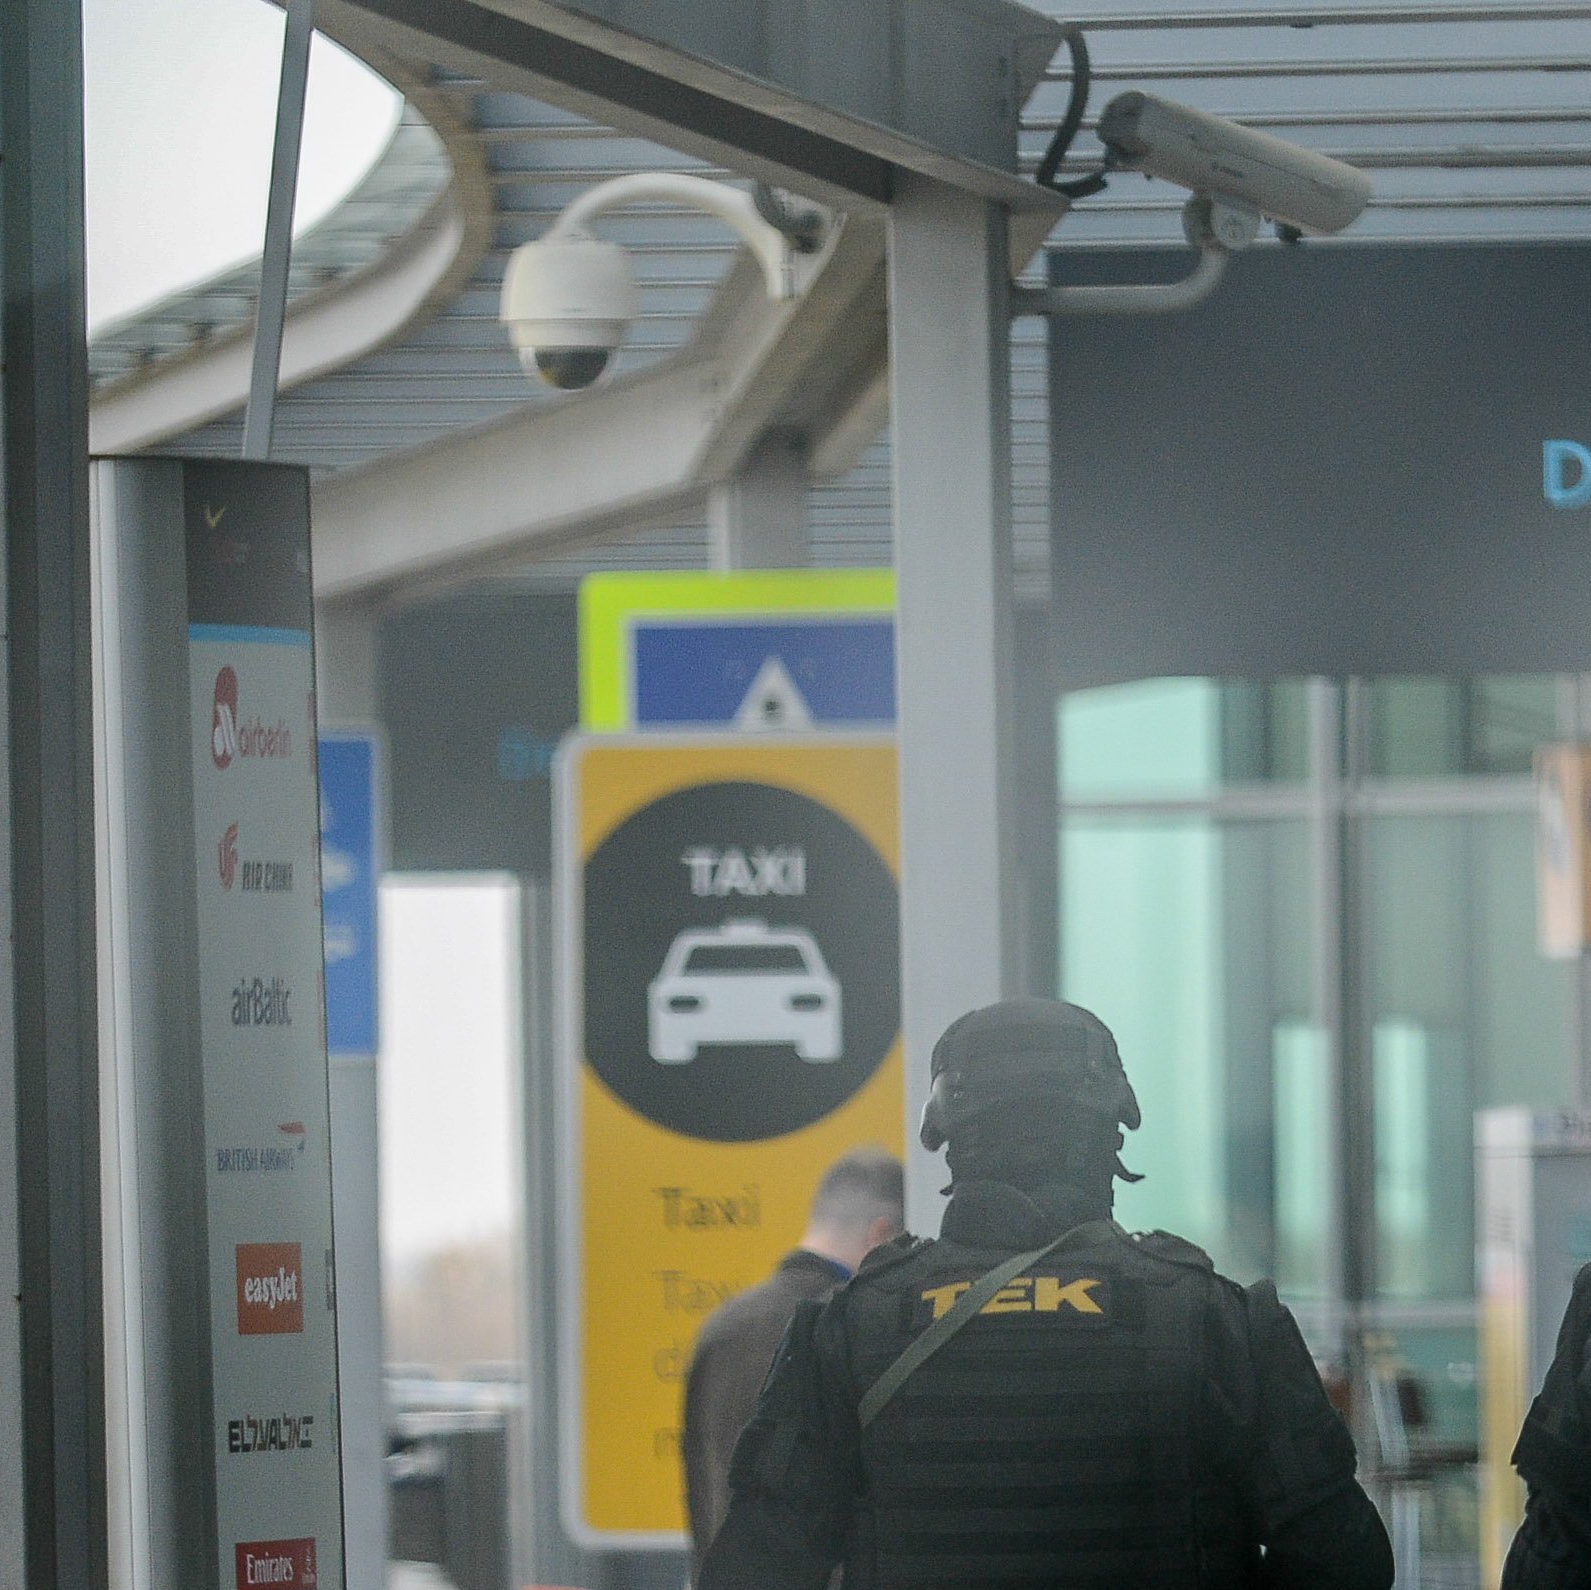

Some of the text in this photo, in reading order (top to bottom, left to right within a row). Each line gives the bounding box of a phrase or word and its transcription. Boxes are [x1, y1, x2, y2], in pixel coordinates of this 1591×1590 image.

[681, 845, 807, 897] TAXI
[654, 1183, 761, 1230] Taxi
[244, 1267, 298, 1310] easyJet
[921, 1276, 1104, 1321] TEK
[246, 1550, 295, 1585] Emirates
